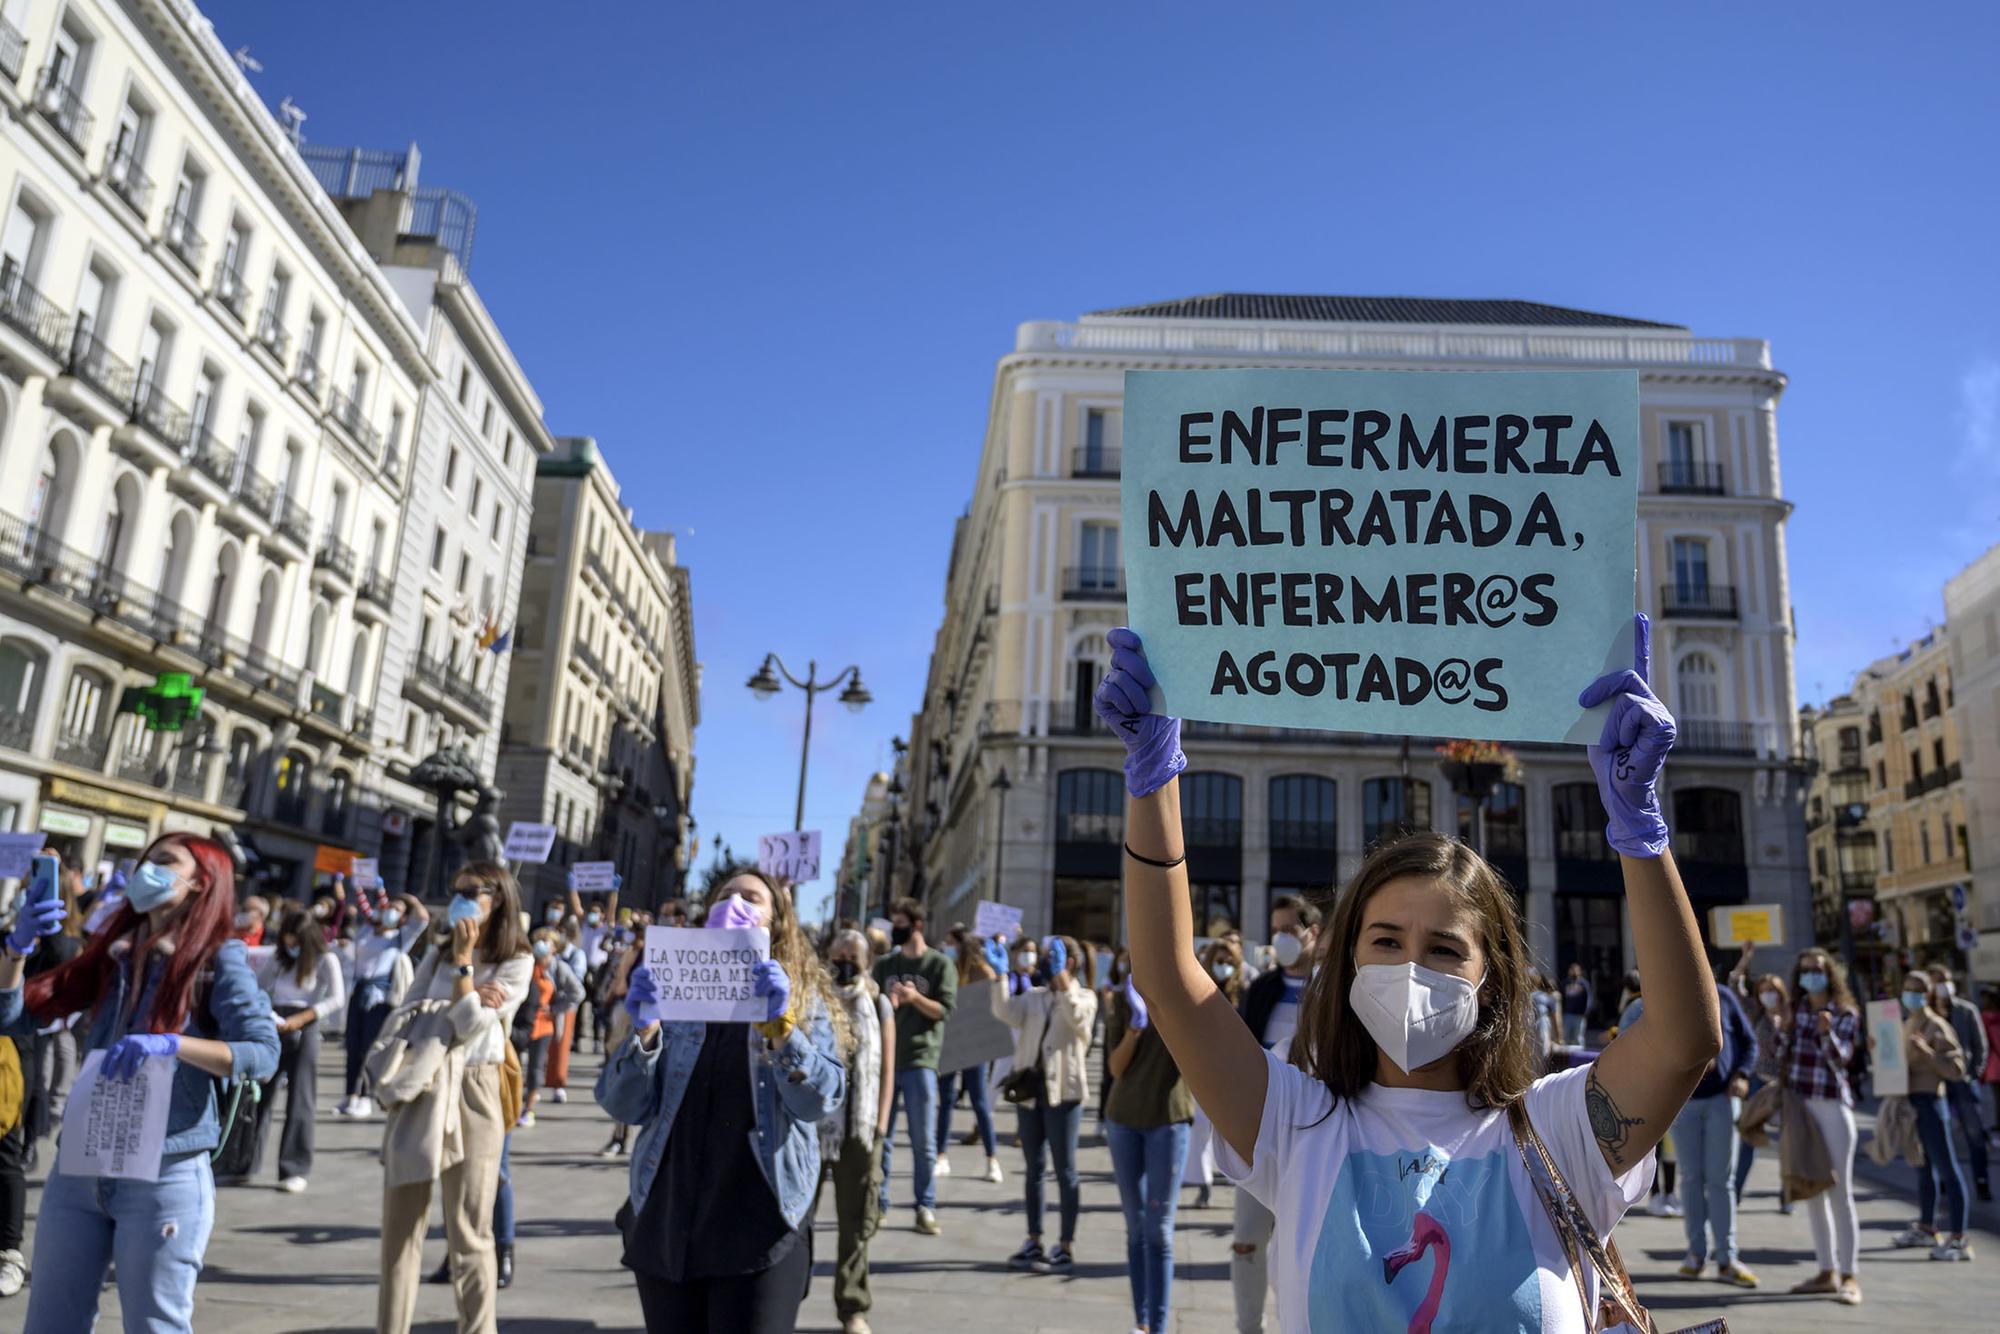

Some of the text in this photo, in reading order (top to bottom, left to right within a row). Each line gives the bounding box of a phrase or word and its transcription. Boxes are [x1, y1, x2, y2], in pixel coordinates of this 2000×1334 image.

[1179, 406, 1622, 477] ENFERMERIA
[1148, 488, 1584, 552] MALTRATADA,
[1174, 572, 1559, 628] ENFERMER@S
[1210, 650, 1509, 712] AGOTAD@S
[650, 948, 763, 965] LA VOCACION
[651, 967, 673, 982] NO
[680, 968, 722, 983] PAGA
[662, 985, 751, 1001] FACTURAS
[130, 1115, 143, 1129] SU
[127, 1133, 141, 1156] POR
